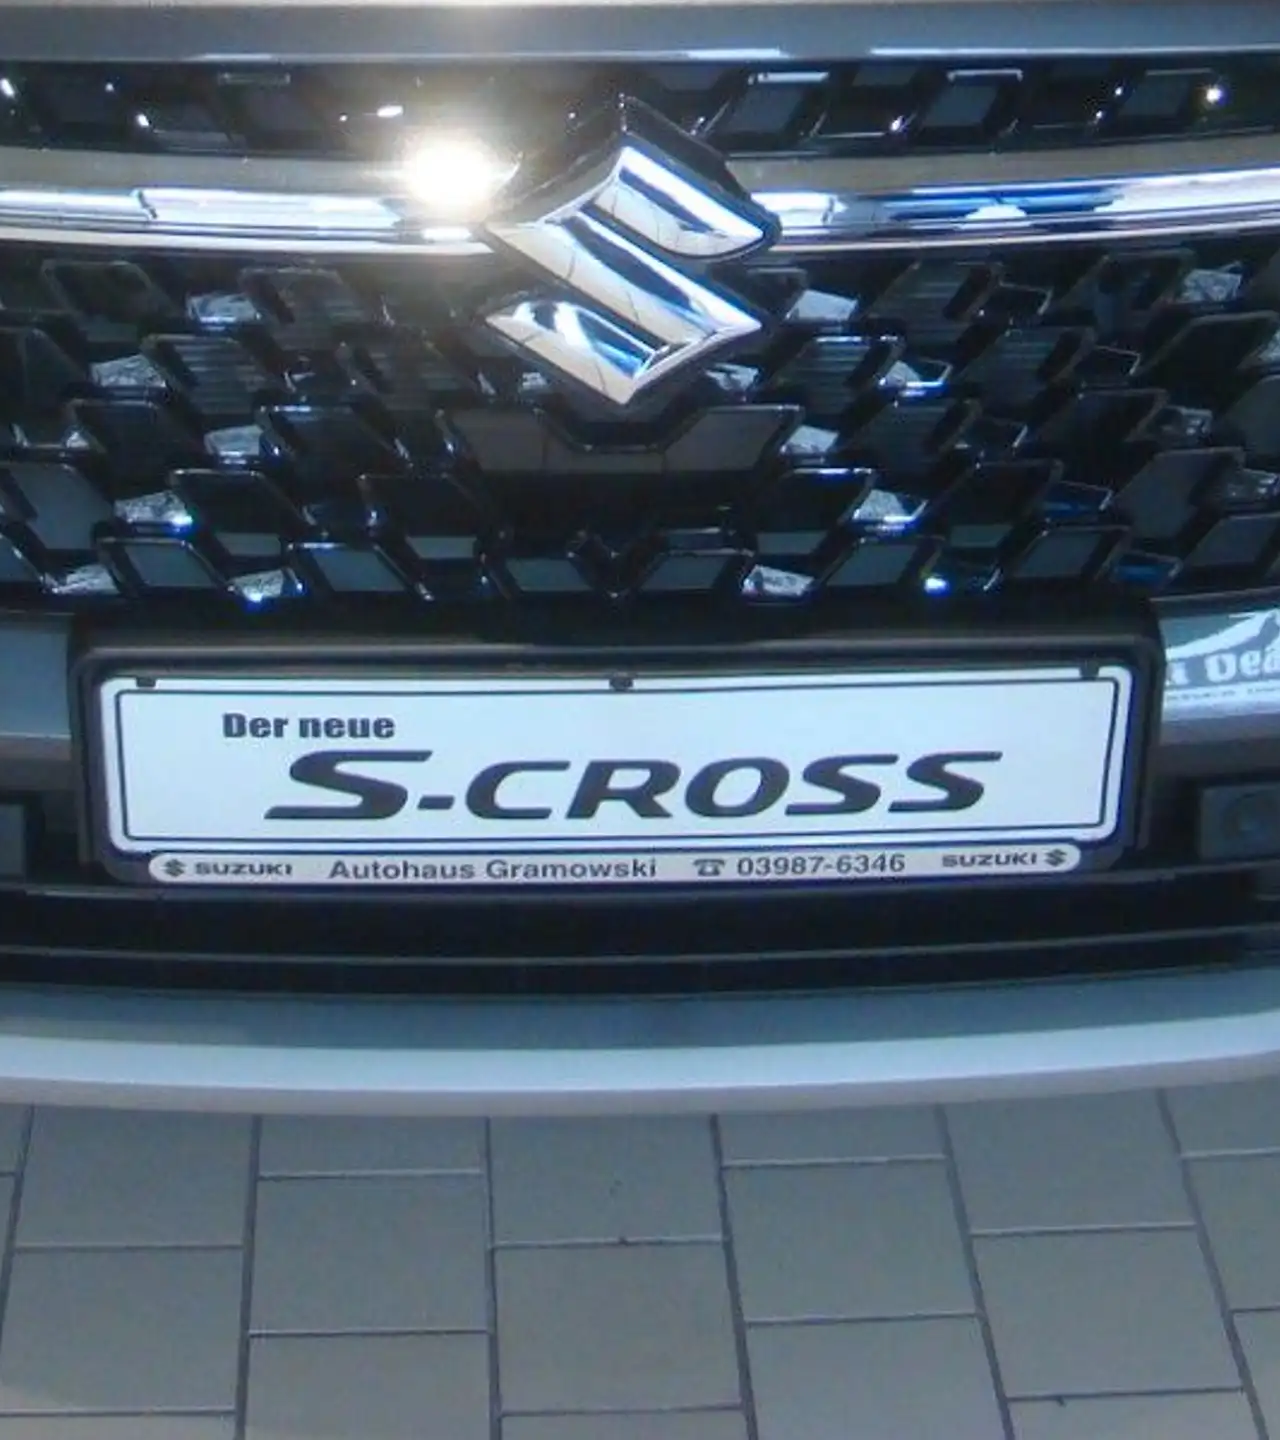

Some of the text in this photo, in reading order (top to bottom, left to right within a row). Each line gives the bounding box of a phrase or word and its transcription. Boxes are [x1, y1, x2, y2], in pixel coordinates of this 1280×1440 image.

[222, 712, 395, 741] Der neue
[263, 749, 1004, 822] S-CROSS
[194, 852, 1038, 882] SUZUKI Autohaus Gramowski 03987-6346 SUZUKI
